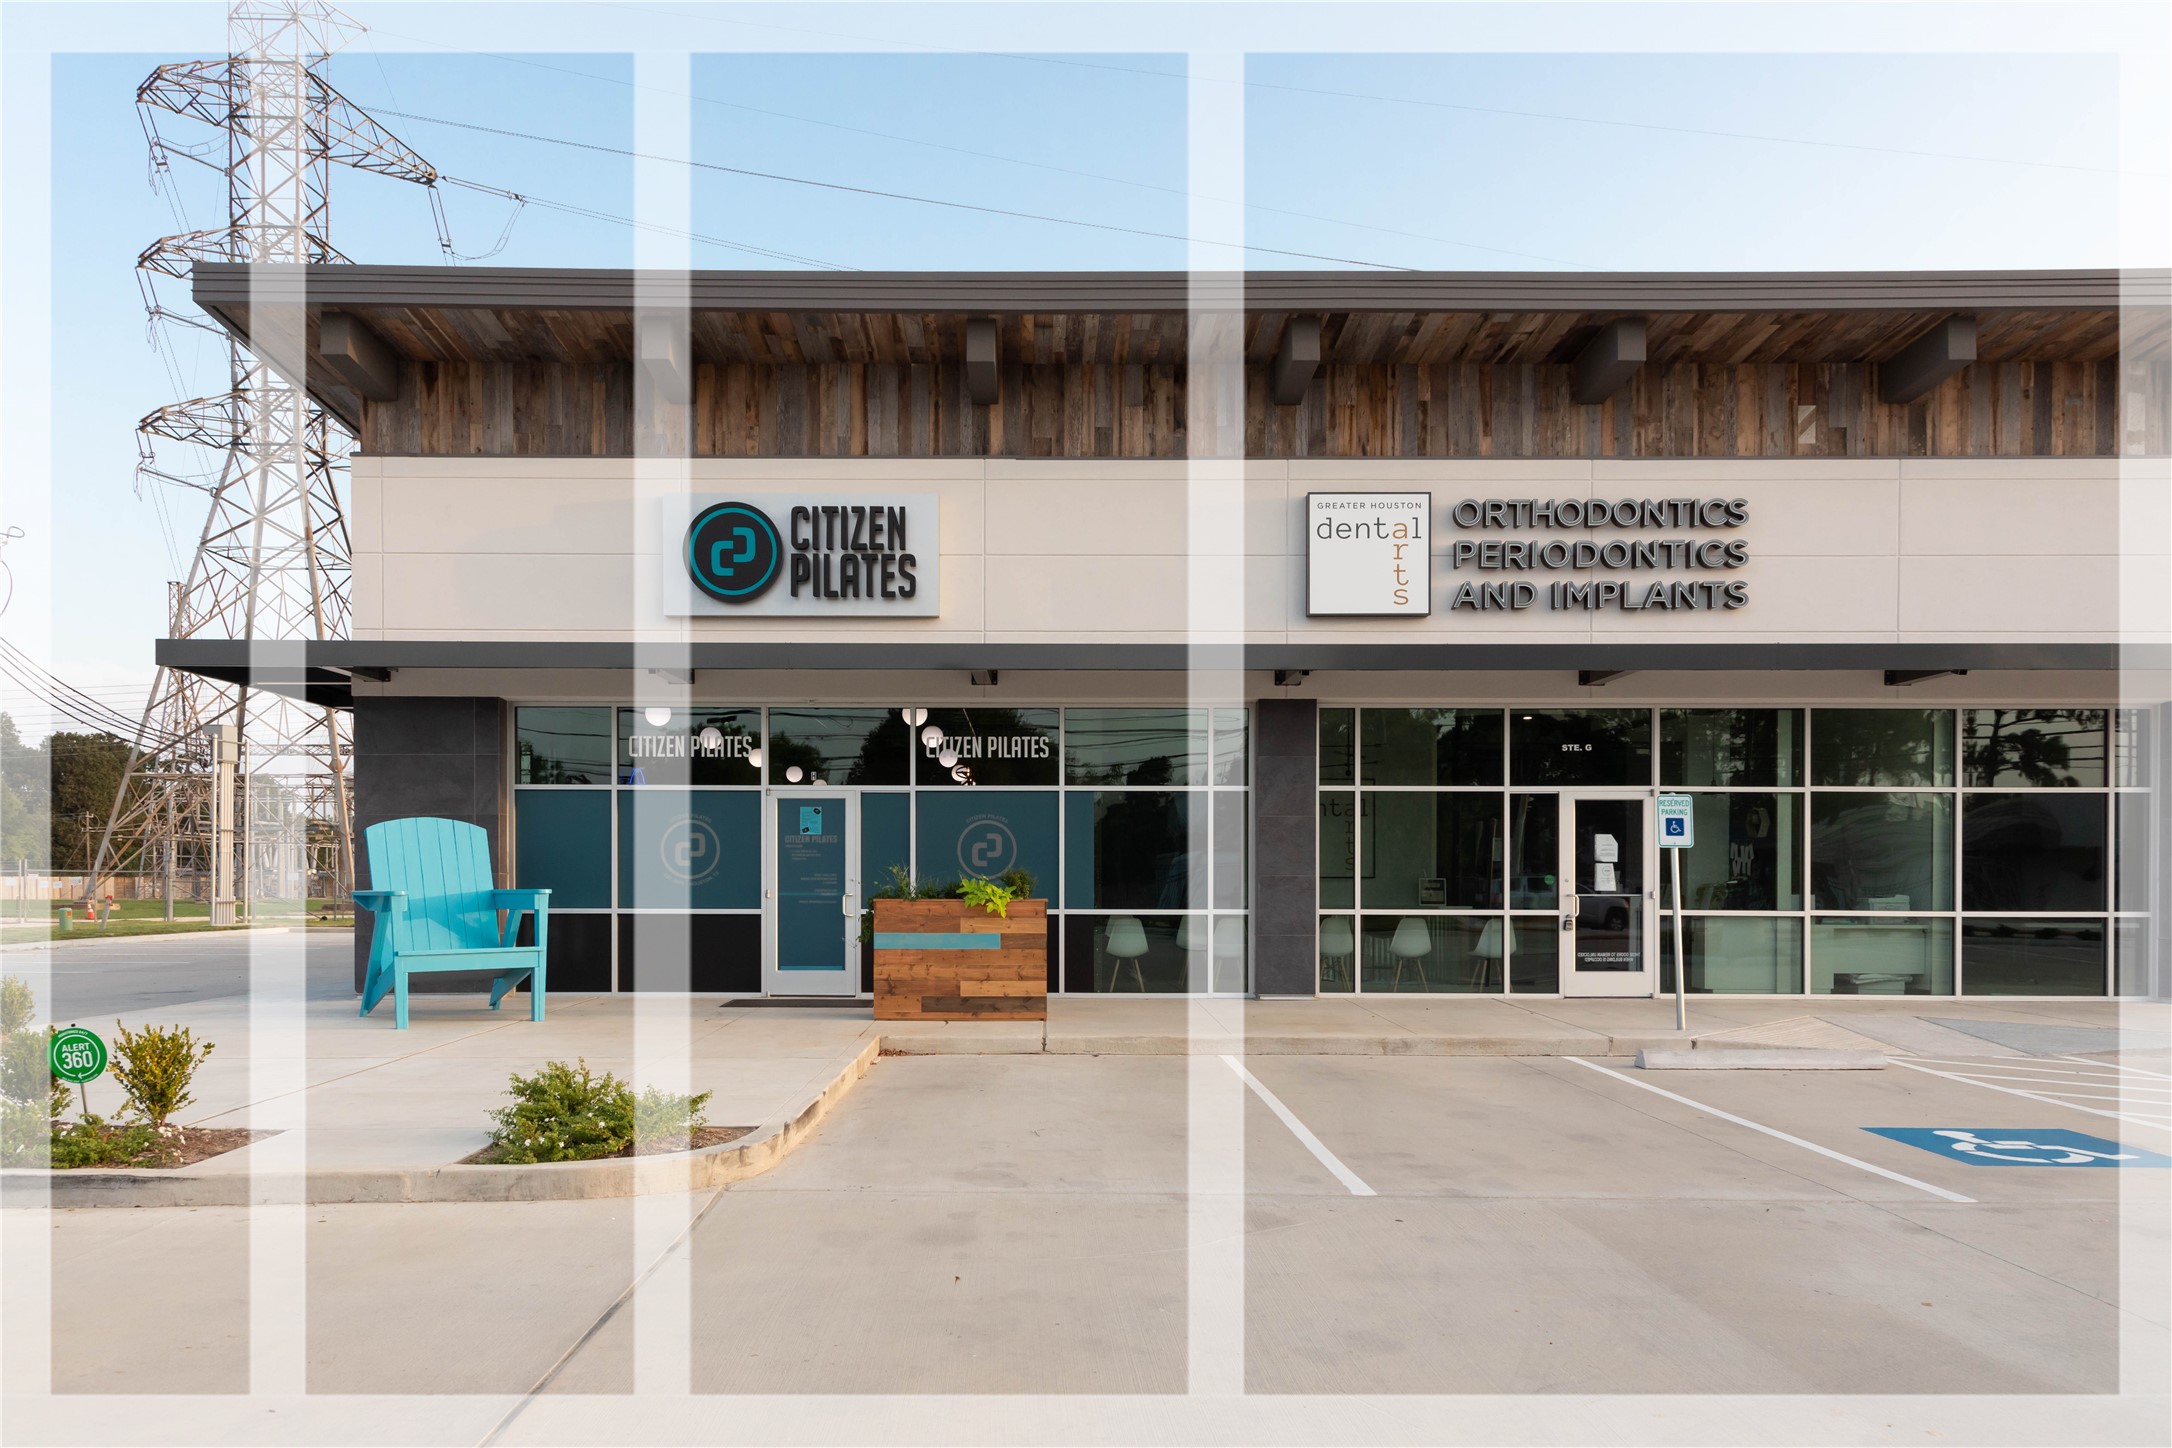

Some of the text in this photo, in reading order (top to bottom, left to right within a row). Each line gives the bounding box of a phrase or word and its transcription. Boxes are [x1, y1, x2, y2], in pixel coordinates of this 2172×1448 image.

[1453, 498, 1750, 528] ORTHODONTICS
[791, 506, 906, 550] CITIZEN
[1317, 517, 1422, 539] dental
[1453, 539, 1750, 569] PERIODONTICS
[790, 553, 917, 598] PILATES
[1452, 580, 1750, 609] AND IMPLANTS
[628, 735, 753, 758] CITIZEN PILATES
[926, 736, 1050, 758] CITIZEN PILATES
[811, 834, 838, 843] PILATES
[62, 1042, 90, 1052] ALERT
[62, 1051, 93, 1069] 360
